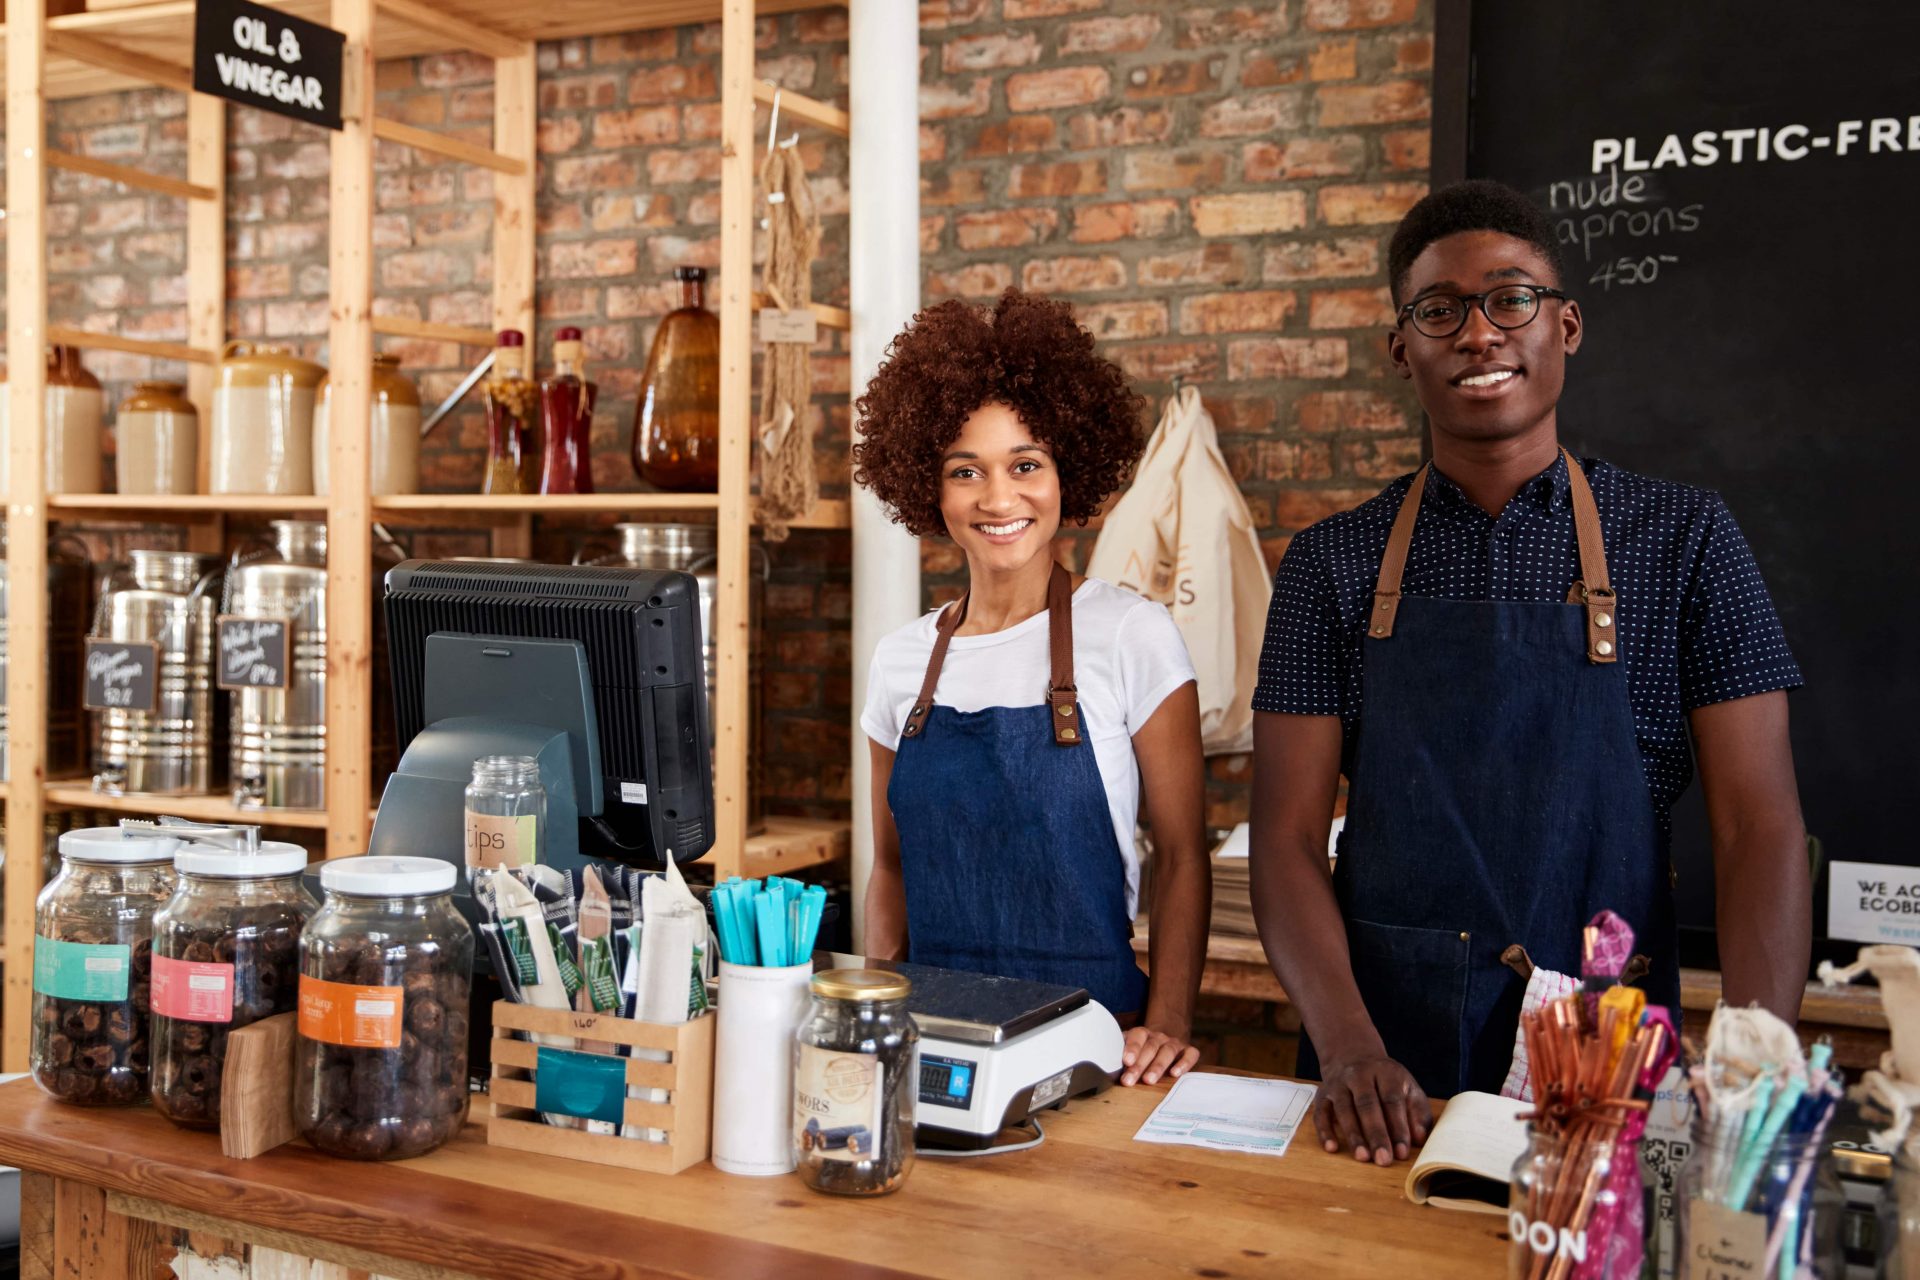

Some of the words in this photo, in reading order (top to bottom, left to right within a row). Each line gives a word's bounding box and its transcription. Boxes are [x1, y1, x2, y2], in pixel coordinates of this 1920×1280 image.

[233, 16, 276, 56] OIL
[278, 28, 302, 63] &
[215, 53, 324, 111] VINEGAR
[1550, 164, 1647, 209] nude
[1556, 204, 1704, 261] aprons
[467, 818, 505, 861] tips
[1858, 880, 1888, 896] WE
